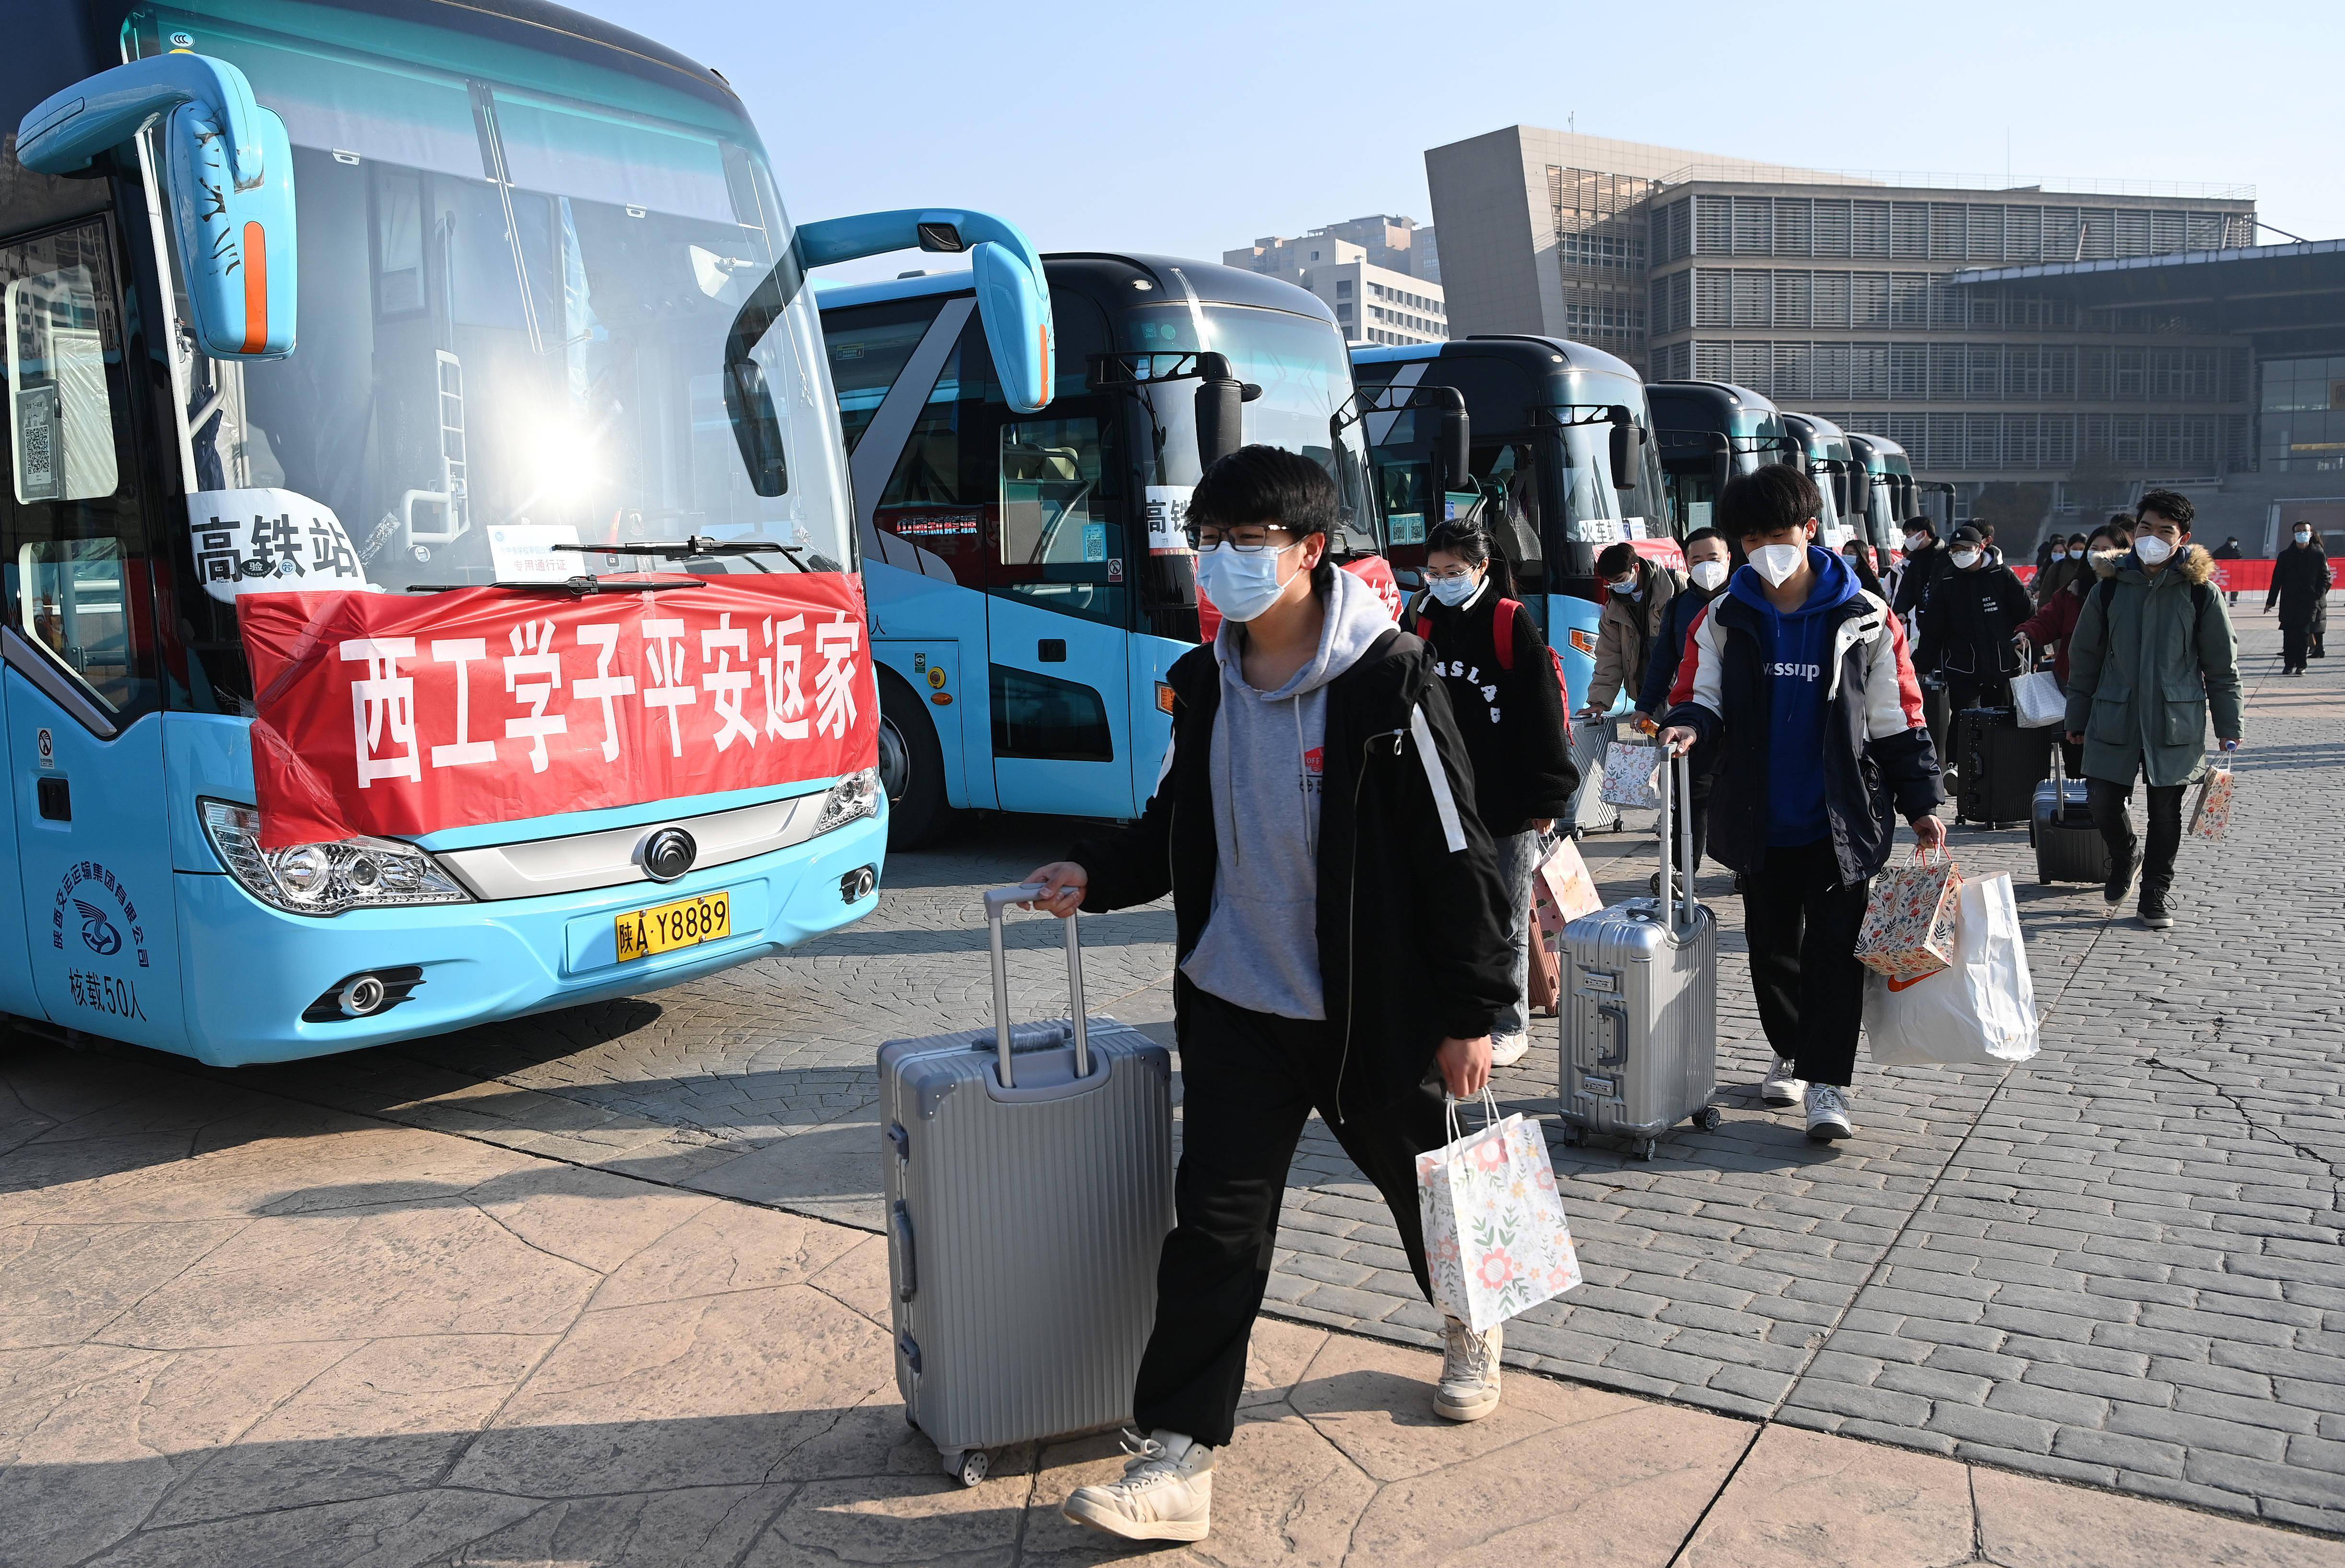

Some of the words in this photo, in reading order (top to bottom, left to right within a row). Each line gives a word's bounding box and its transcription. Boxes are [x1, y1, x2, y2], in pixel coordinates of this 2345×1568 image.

[191, 514, 358, 585] 高铁站
[514, 559, 567, 571] 专用通行证
[339, 612, 860, 788] 西工学子平安返家
[53, 861, 150, 967] 陕西交运运输集团有限公司
[68, 967, 147, 1023] 核载50人
